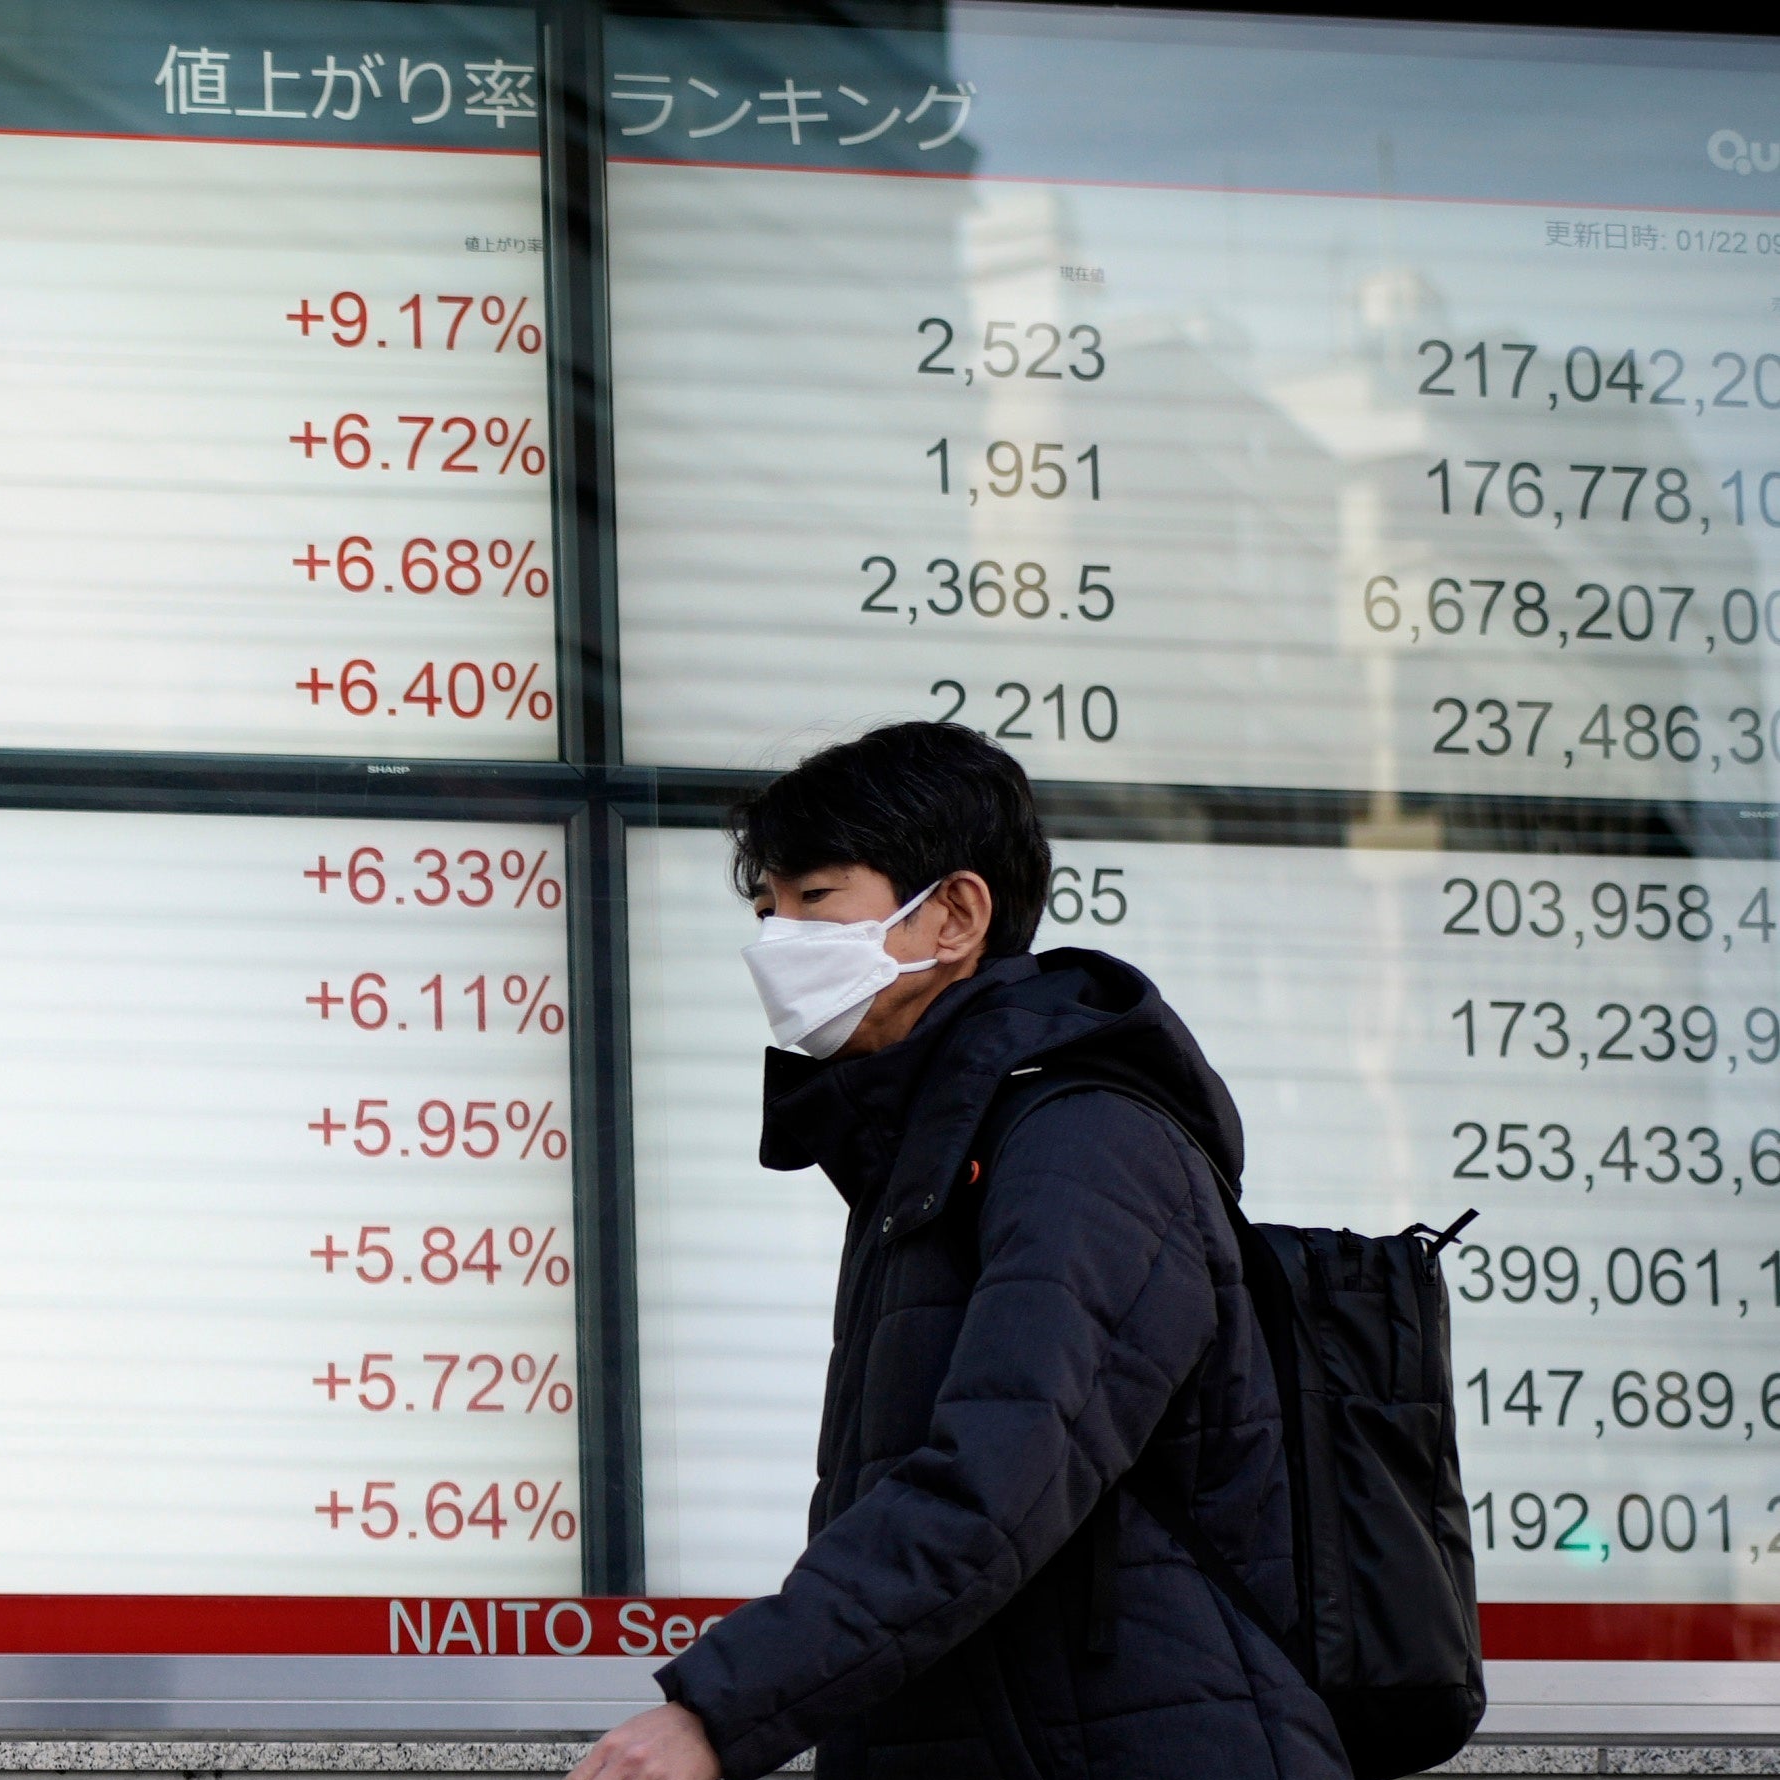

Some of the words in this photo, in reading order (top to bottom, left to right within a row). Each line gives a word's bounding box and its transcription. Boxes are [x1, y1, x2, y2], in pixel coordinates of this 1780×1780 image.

[155, 44, 538, 129] 値上がり率
[611, 71, 977, 151] ランキング
[1545, 218, 1667, 250] 更新日時:
[1676, 229, 1747, 254] 01/22
[286, 291, 541, 354] +9.17%
[917, 317, 1107, 387] 2,523
[1418, 340, 1780, 412] 217,042,20
[289, 414, 546, 476] +6.72%
[926, 437, 1103, 504] 1,951
[1427, 459, 1780, 534] 176,778,10
[292, 536, 550, 599] +6.68%
[861, 556, 1115, 624] 2,368.5
[295, 659, 553, 722] +6.40%
[1433, 697, 1780, 772] 237,486,3
[367, 766, 411, 775] SHARP
[303, 846, 562, 909] +6.33%
[1442, 878, 1777, 952] 203,958,4
[305, 972, 565, 1035] +6.11%
[1451, 1000, 1780, 1072] 173,239,9
[308, 1099, 567, 1161] +5.95%
[1452, 1122, 1780, 1196] 253,433,6
[310, 1226, 571, 1287] +5.84%
[312, 1353, 574, 1414] +5.72%
[315, 1480, 577, 1542] +5.64%
[389, 1600, 593, 1656] NAITO
